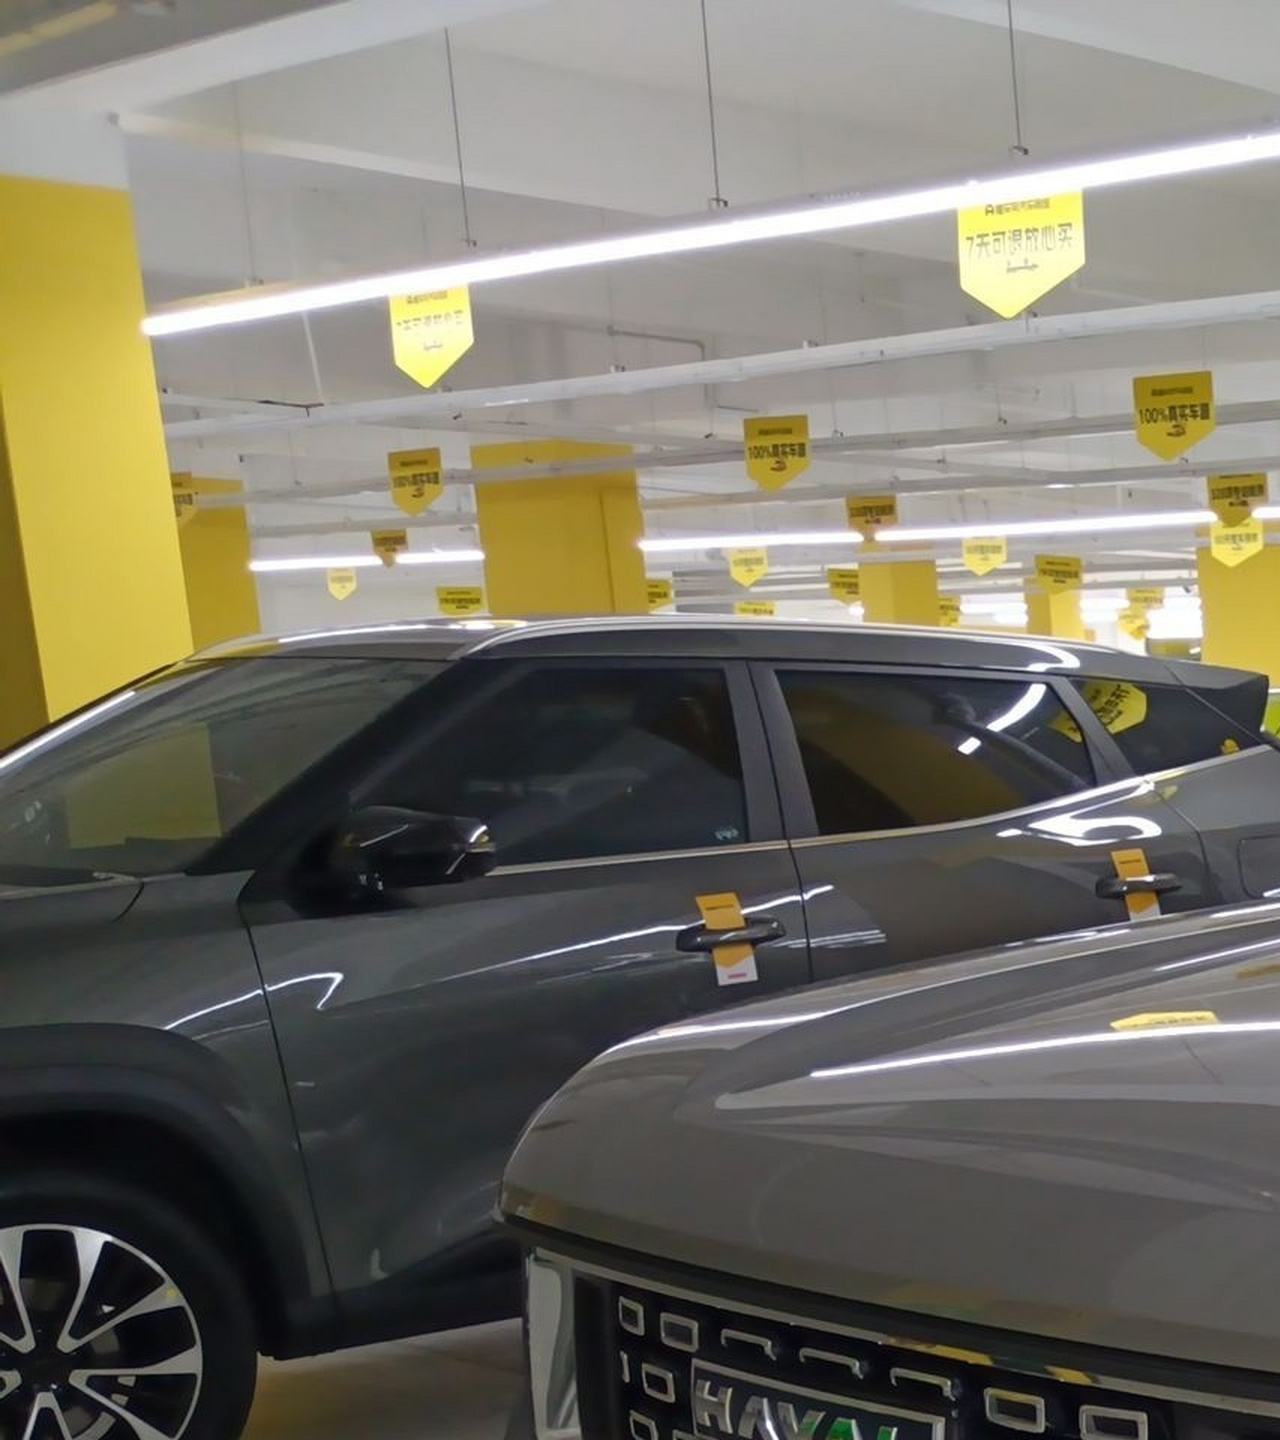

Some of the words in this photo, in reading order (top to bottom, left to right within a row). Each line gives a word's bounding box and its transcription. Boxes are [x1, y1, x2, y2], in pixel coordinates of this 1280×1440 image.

[965, 221, 1073, 258] 7天可退放心买
